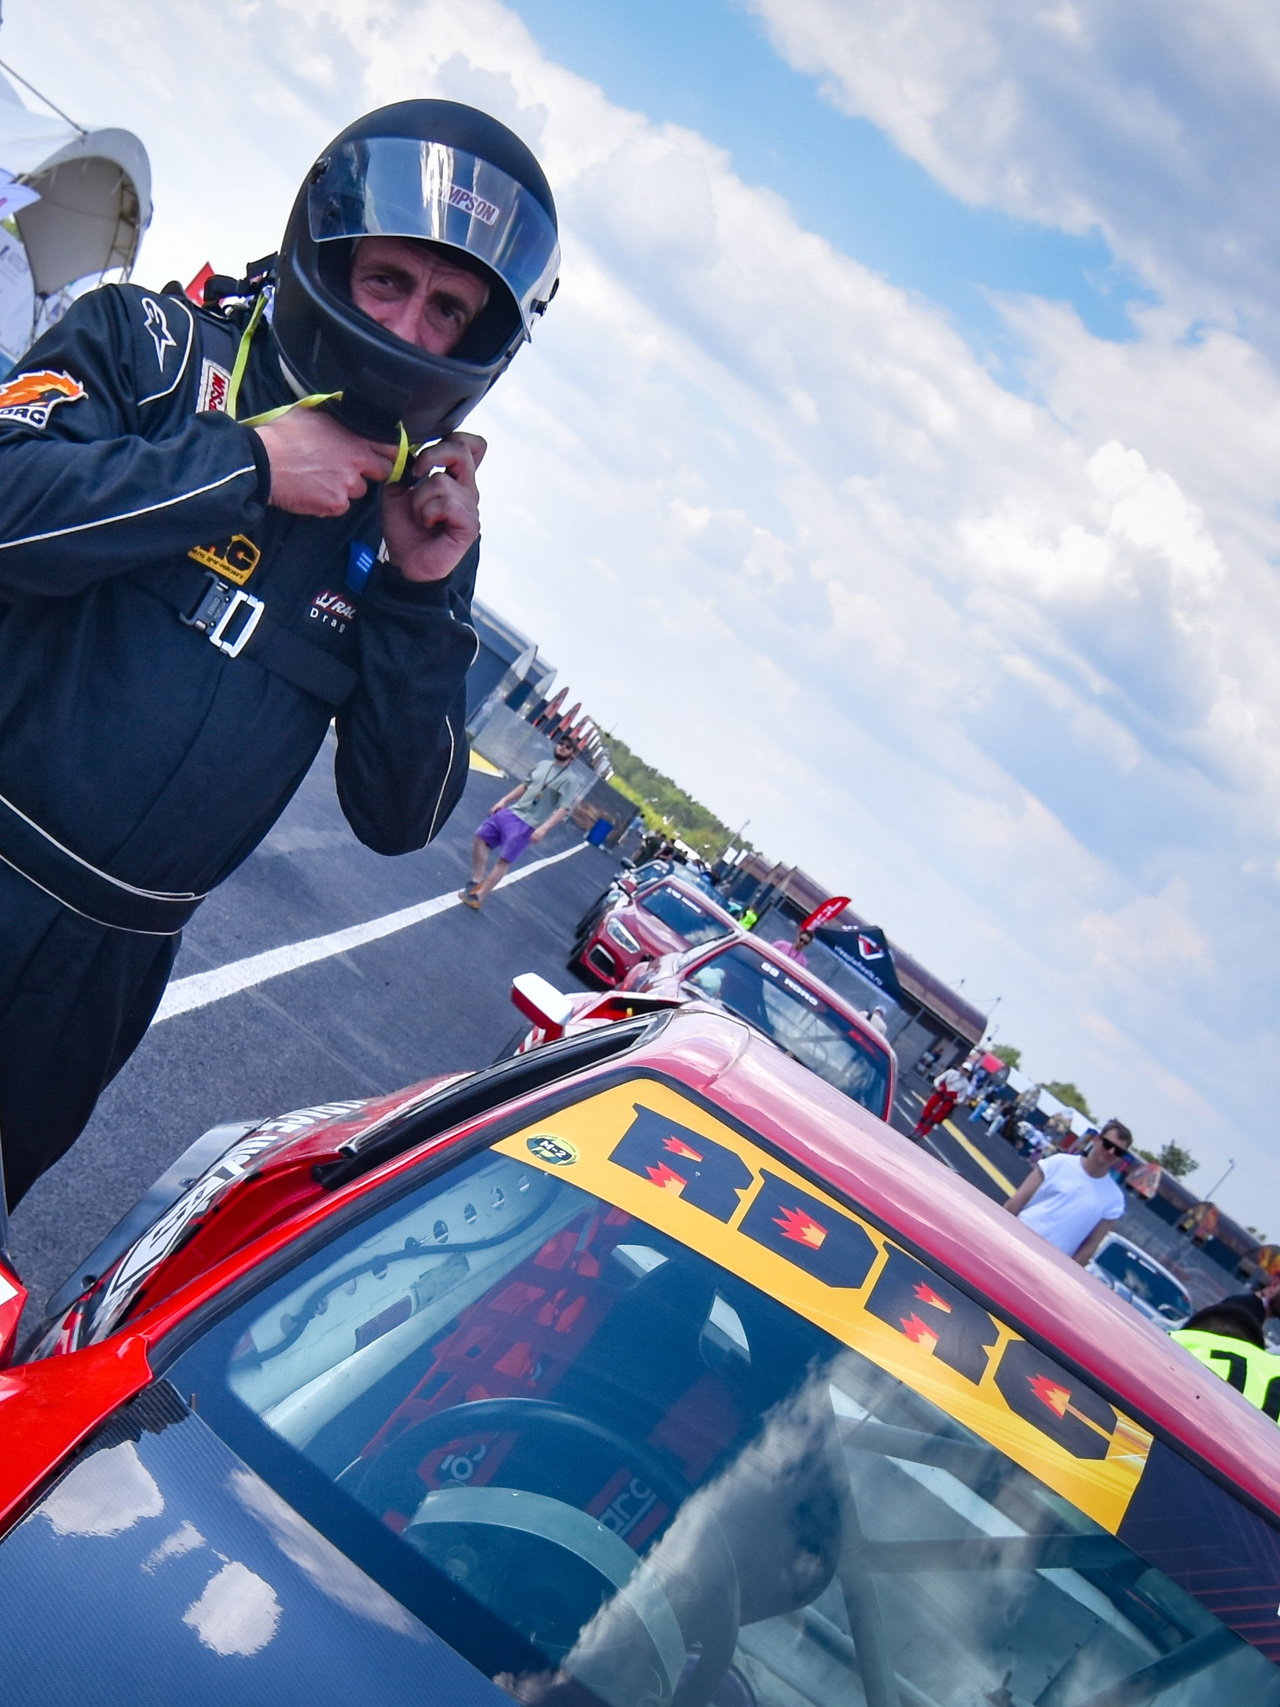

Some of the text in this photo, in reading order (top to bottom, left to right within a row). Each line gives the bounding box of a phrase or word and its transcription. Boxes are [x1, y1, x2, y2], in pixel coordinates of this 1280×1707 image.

[448, 186, 496, 222] MPSON
[209, 371, 226, 412] PSON
[540, 1140, 567, 1158] M-2
[607, 1103, 1118, 1460] RDRC
